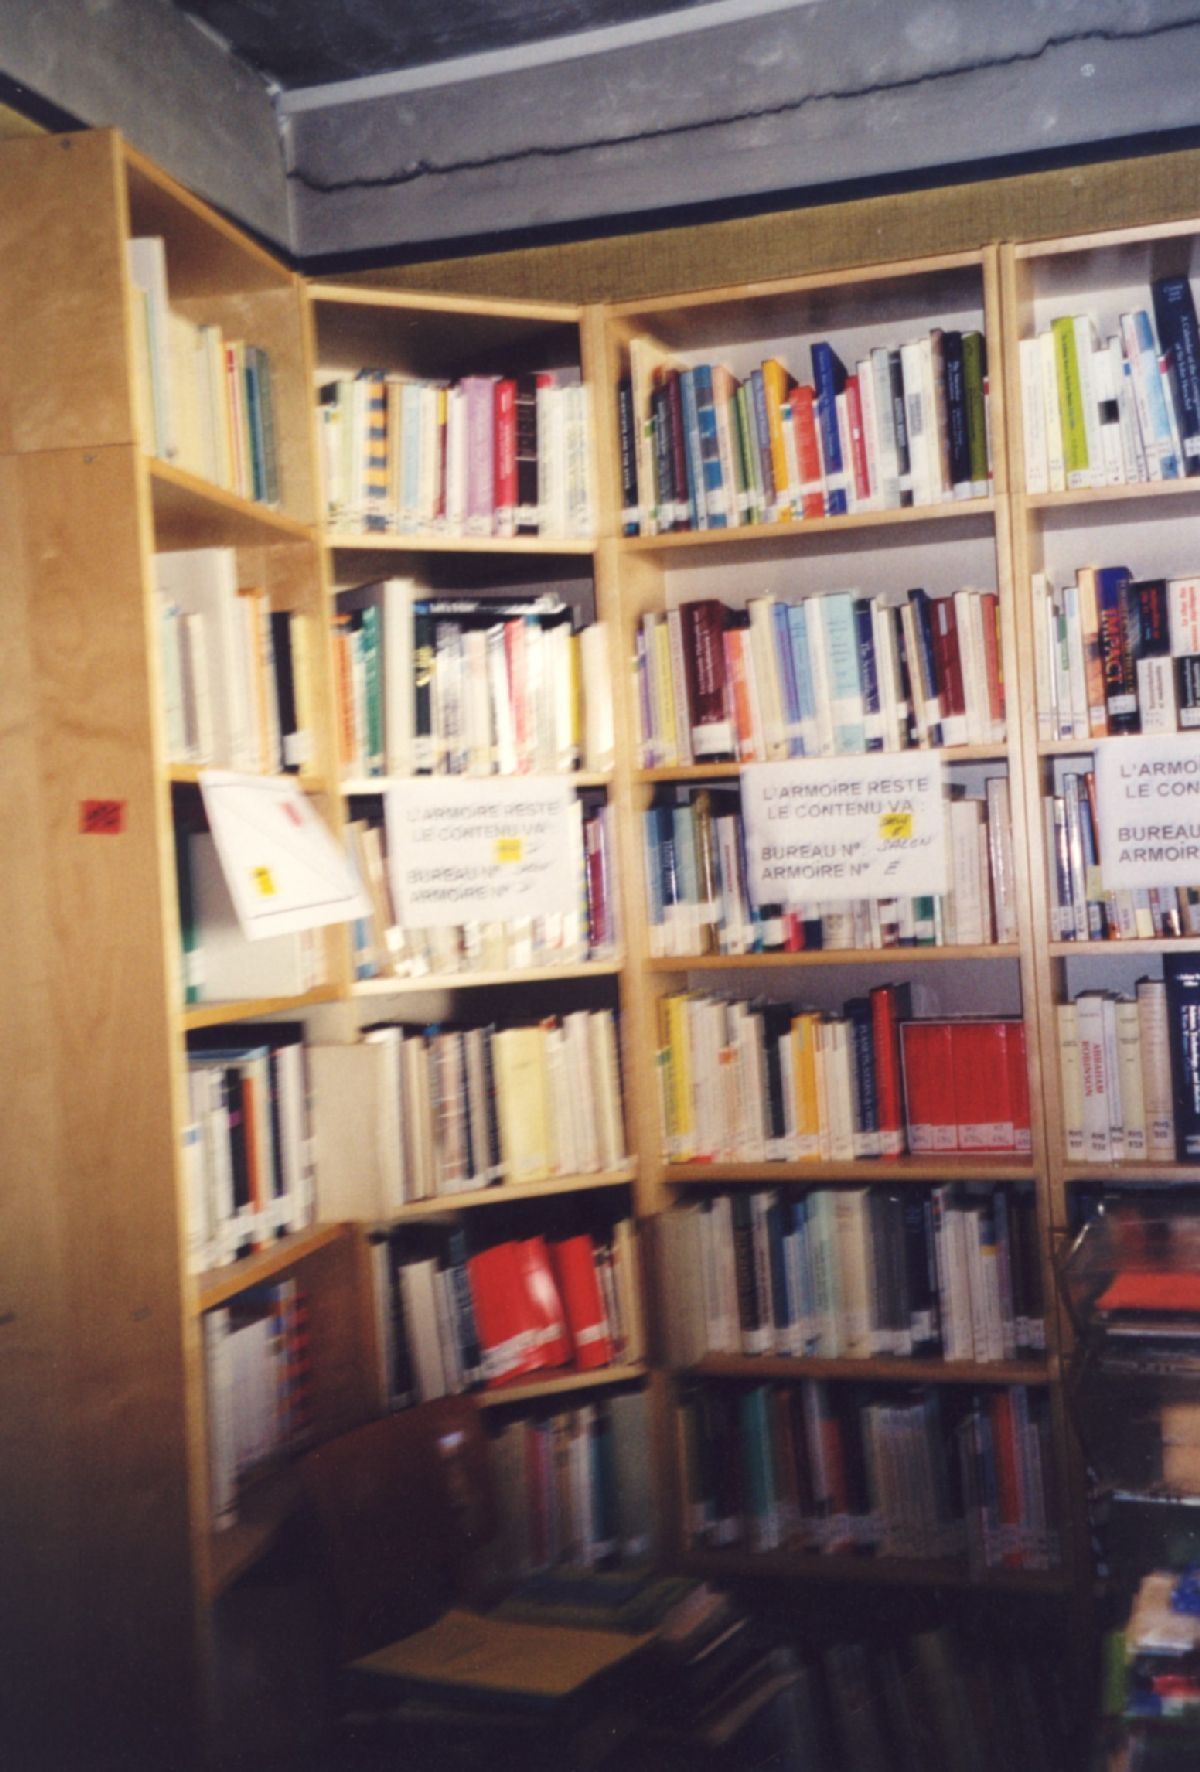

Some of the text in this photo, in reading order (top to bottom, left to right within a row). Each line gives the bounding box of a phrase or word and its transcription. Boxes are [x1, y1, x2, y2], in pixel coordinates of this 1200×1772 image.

[1102, 608, 1122, 684] IMPACT
[868, 777, 928, 795] RESTE
[1126, 783, 1150, 798] LE
[768, 805, 789, 819] LE
[795, 801, 882, 818] CONTENU
[887, 800, 914, 813] VA
[761, 844, 836, 861] BUREAU
[762, 863, 844, 880] ARMOIRE
